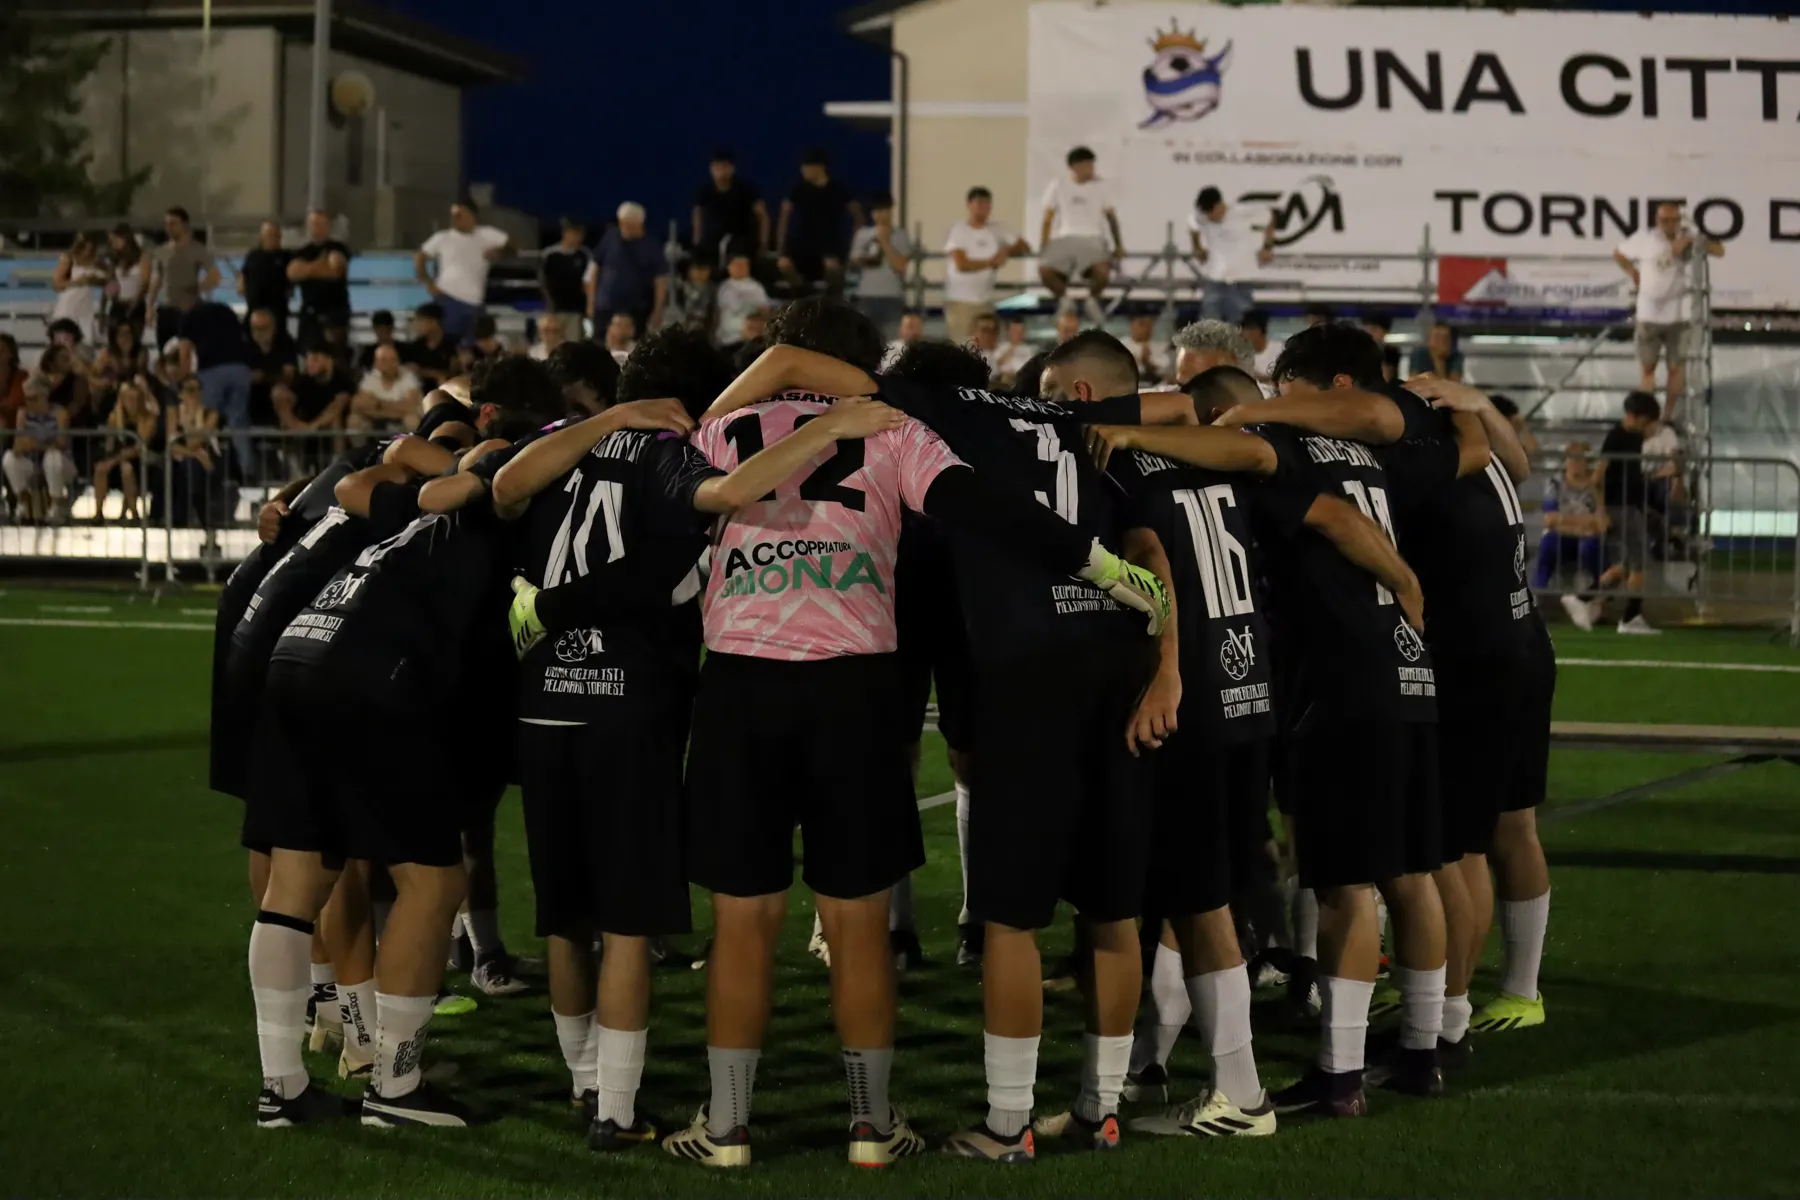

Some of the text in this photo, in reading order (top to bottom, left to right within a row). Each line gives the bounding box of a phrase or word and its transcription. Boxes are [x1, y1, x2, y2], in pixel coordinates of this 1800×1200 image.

[1294, 46, 1800, 121] UNA CITT
[1173, 152, 1190, 163] IN
[1194, 151, 1359, 167] COLLABORAZIONE
[724, 411, 867, 513] 12
[720, 551, 887, 599] SIMONA
[725, 539, 851, 579] ACCOPPIATURA
[1171, 483, 1255, 619] 16
